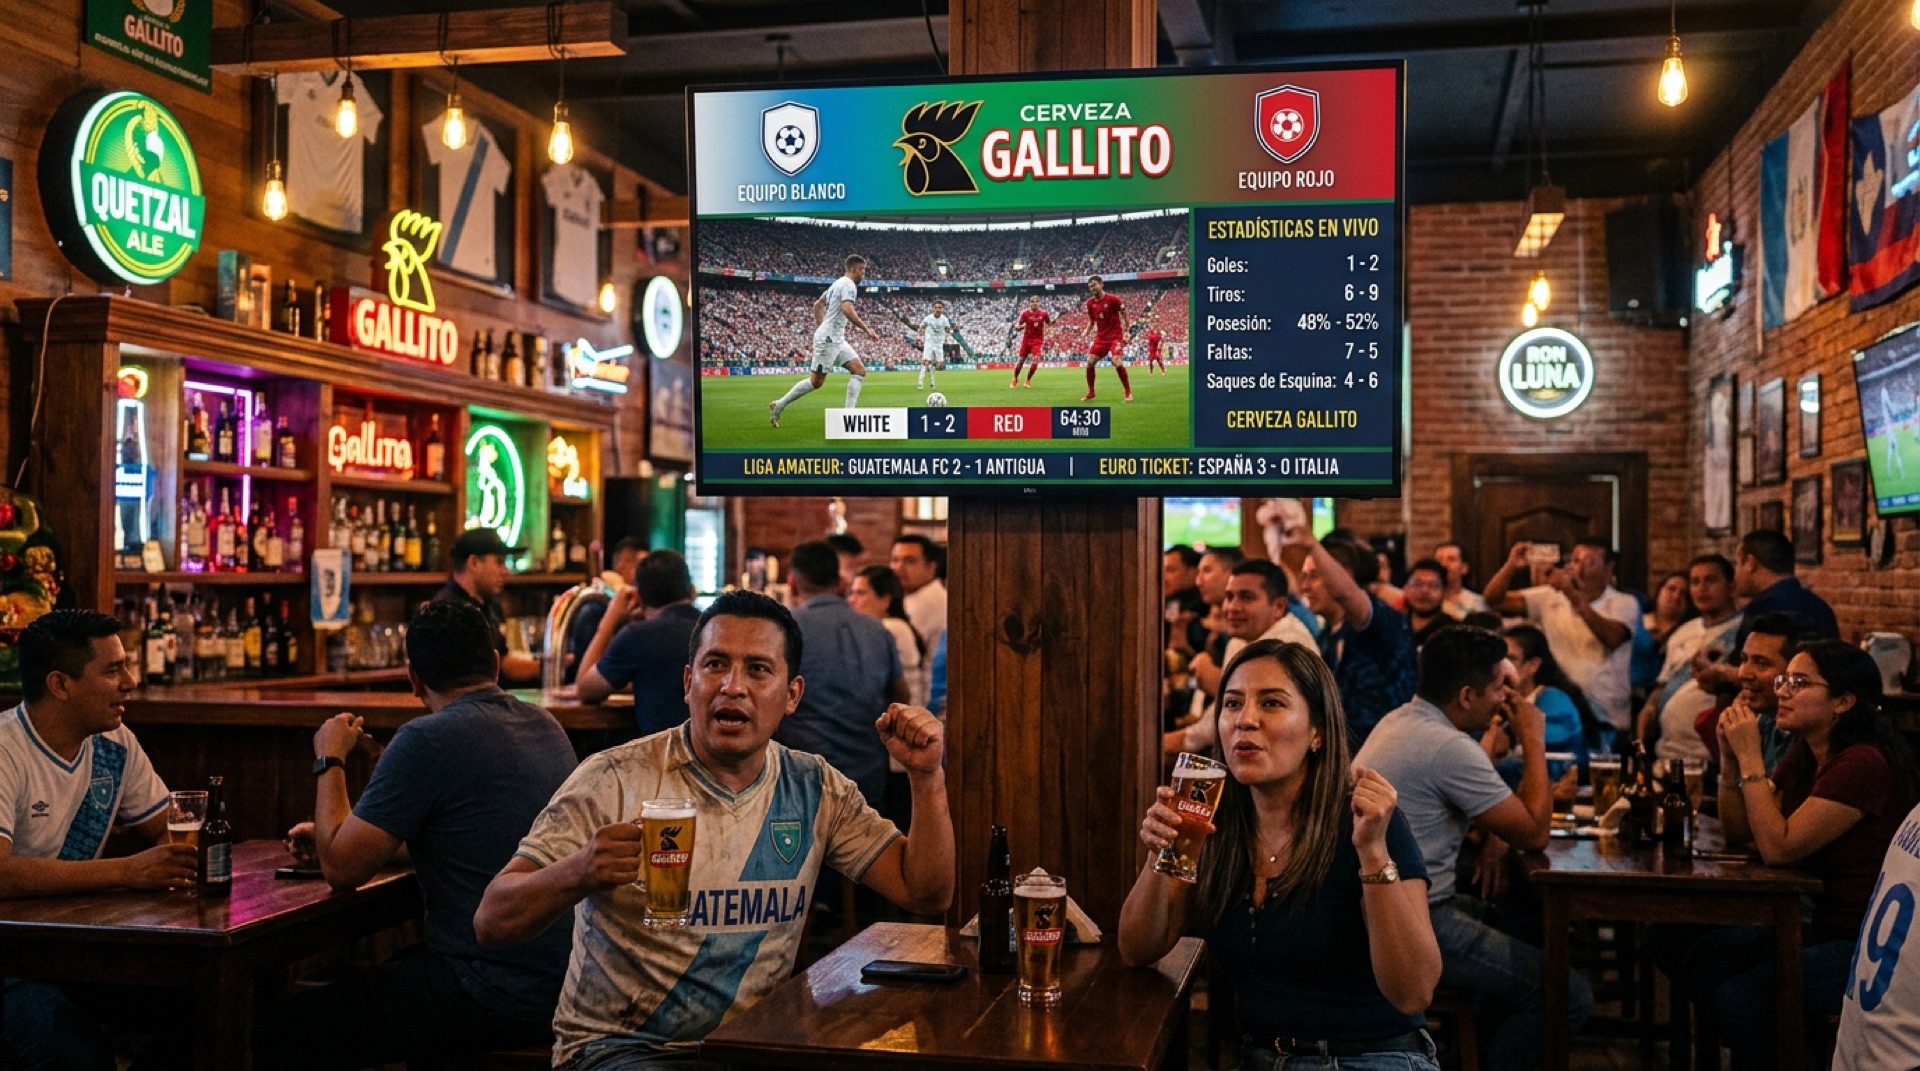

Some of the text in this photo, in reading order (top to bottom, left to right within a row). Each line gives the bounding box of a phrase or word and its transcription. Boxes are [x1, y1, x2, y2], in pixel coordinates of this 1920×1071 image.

[124, 14, 184, 58] GALLITO
[1020, 102, 1132, 122] CERVEZA
[982, 124, 1173, 180] GALLITO
[1238, 169, 1336, 191] EQUIPO ROJO
[737, 182, 846, 203] EQUIPO BLANCO
[91, 172, 196, 239] QUETZAL
[1207, 216, 1379, 239] ESTADÍSTICAS EN VIVO
[126, 229, 165, 257] ALE
[1207, 256, 1249, 273] Goles:
[1346, 254, 1355, 272] 1
[1369, 254, 1380, 271] 2
[1206, 285, 1246, 303] Tiros:
[1344, 283, 1355, 302] 6
[1368, 283, 1380, 301] 9
[356, 298, 458, 365] GALLITO
[1207, 314, 1272, 331] Posesión:
[1297, 313, 1332, 331] 48%
[1345, 313, 1380, 330] 52%
[1207, 343, 1253, 361] Faltas:
[1344, 342, 1355, 360] 7
[1369, 342, 1379, 359] 5
[1526, 346, 1567, 364] RON
[1207, 372, 1256, 392] Saques
[1259, 372, 1276, 389] de
[1279, 371, 1337, 392] Esquina:
[1343, 371, 1354, 389] 4
[1368, 371, 1379, 389] 6
[1512, 363, 1582, 390] LUNA
[843, 415, 891, 433] WHITE
[920, 414, 928, 433] 1
[944, 413, 956, 432] 2
[993, 414, 1024, 433] RED
[1060, 409, 1102, 426] 64:30
[1226, 410, 1358, 429] CERVEZA GALLITO
[743, 458, 774, 475] LIGA
[777, 458, 844, 475] AMATEUR:
[848, 458, 929, 475] GUATEMALA
[932, 458, 949, 475] FC
[952, 458, 961, 475] 2
[974, 458, 982, 475] 1
[985, 458, 1046, 475] ANTIGUA
[1099, 458, 1137, 475] EURO
[1140, 458, 1194, 475] TICKET:
[1198, 453, 1254, 475] ESPAÑA
[1256, 457, 1267, 475] 3
[1280, 457, 1290, 475] 0
[1294, 457, 1340, 475] ITALIA
[688, 885, 806, 927] ATEMALA
